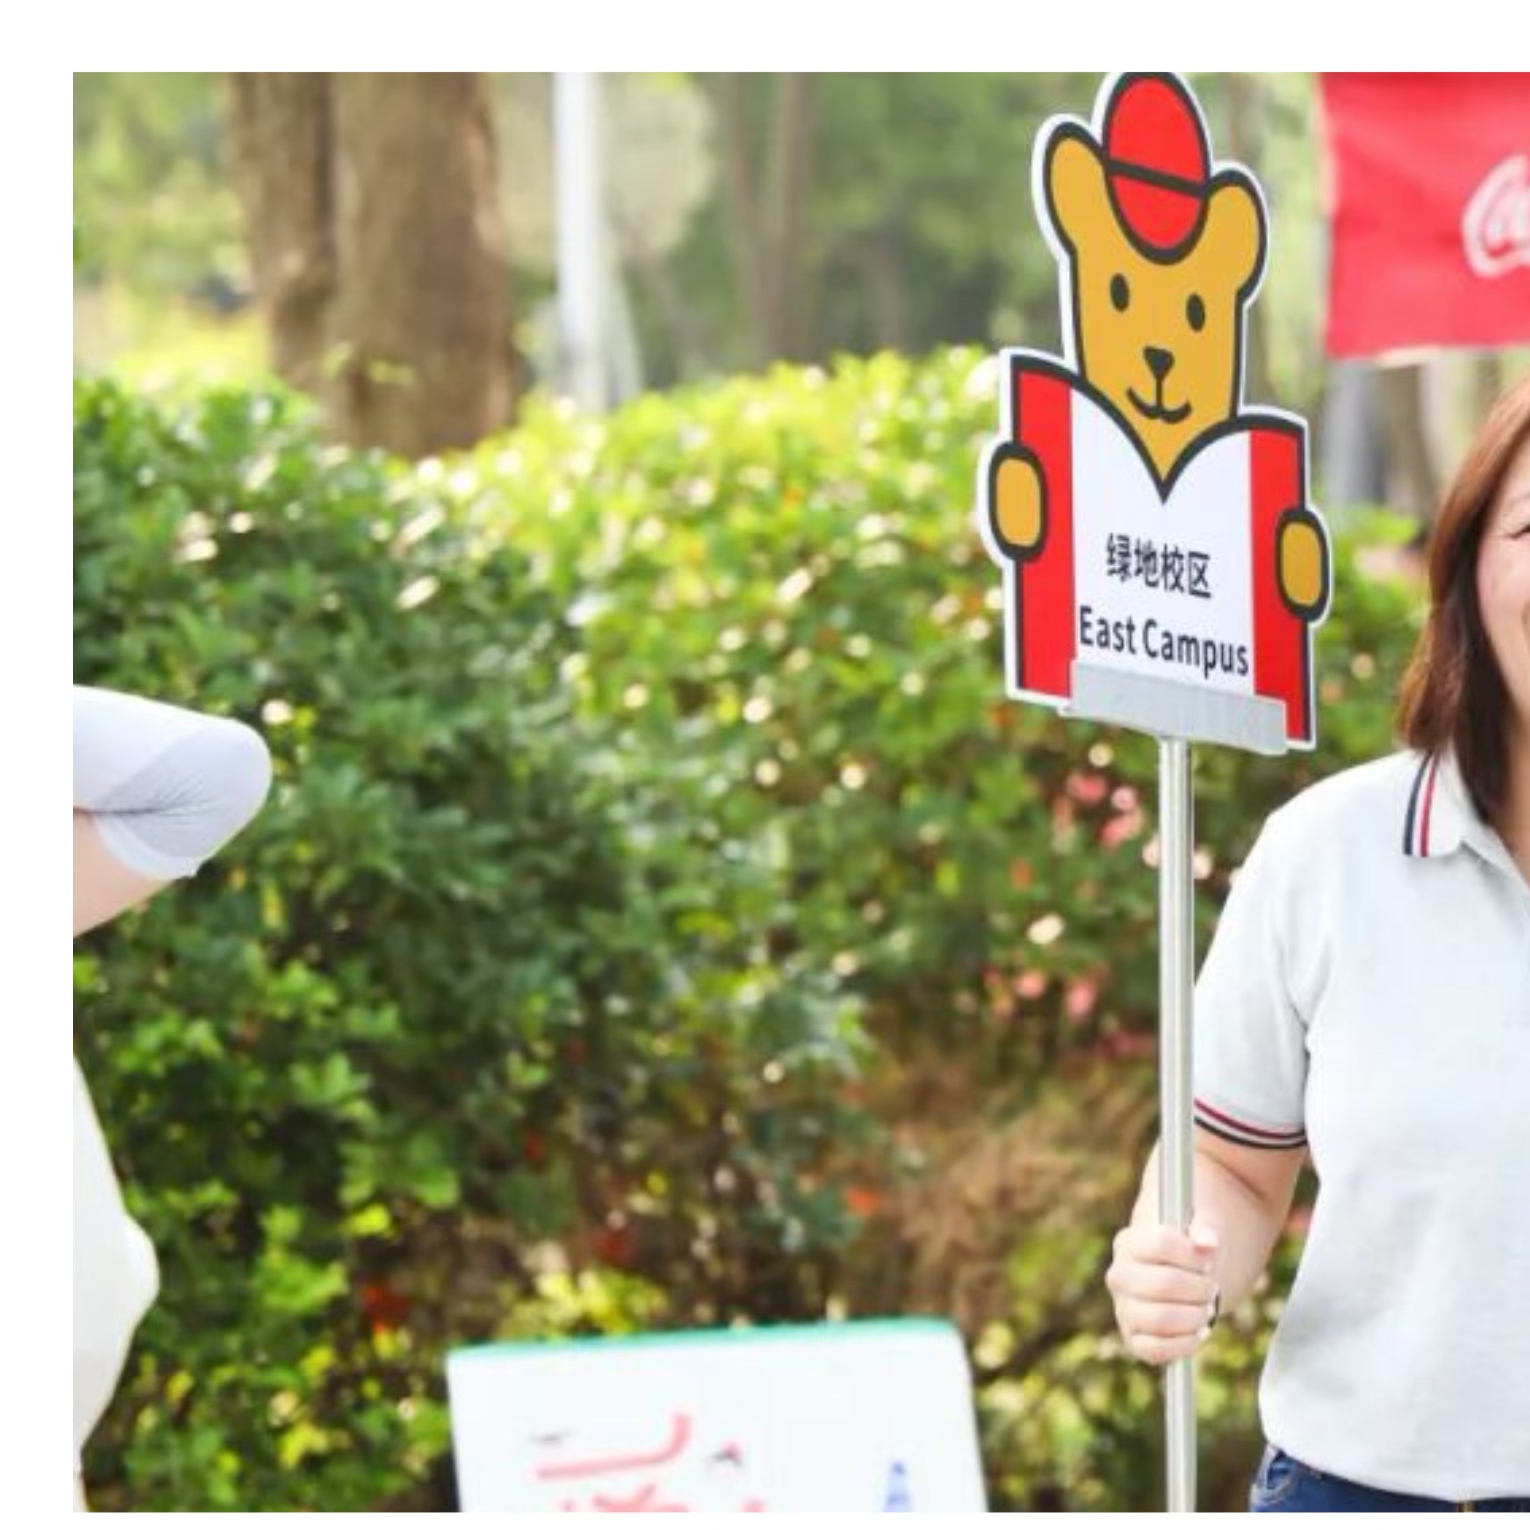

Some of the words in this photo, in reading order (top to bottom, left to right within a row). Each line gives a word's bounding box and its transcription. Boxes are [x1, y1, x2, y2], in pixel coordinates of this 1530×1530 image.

[1106, 533, 1212, 599] 绿地校区
[1080, 606, 1136, 656] East
[1143, 621, 1249, 680] Campus
